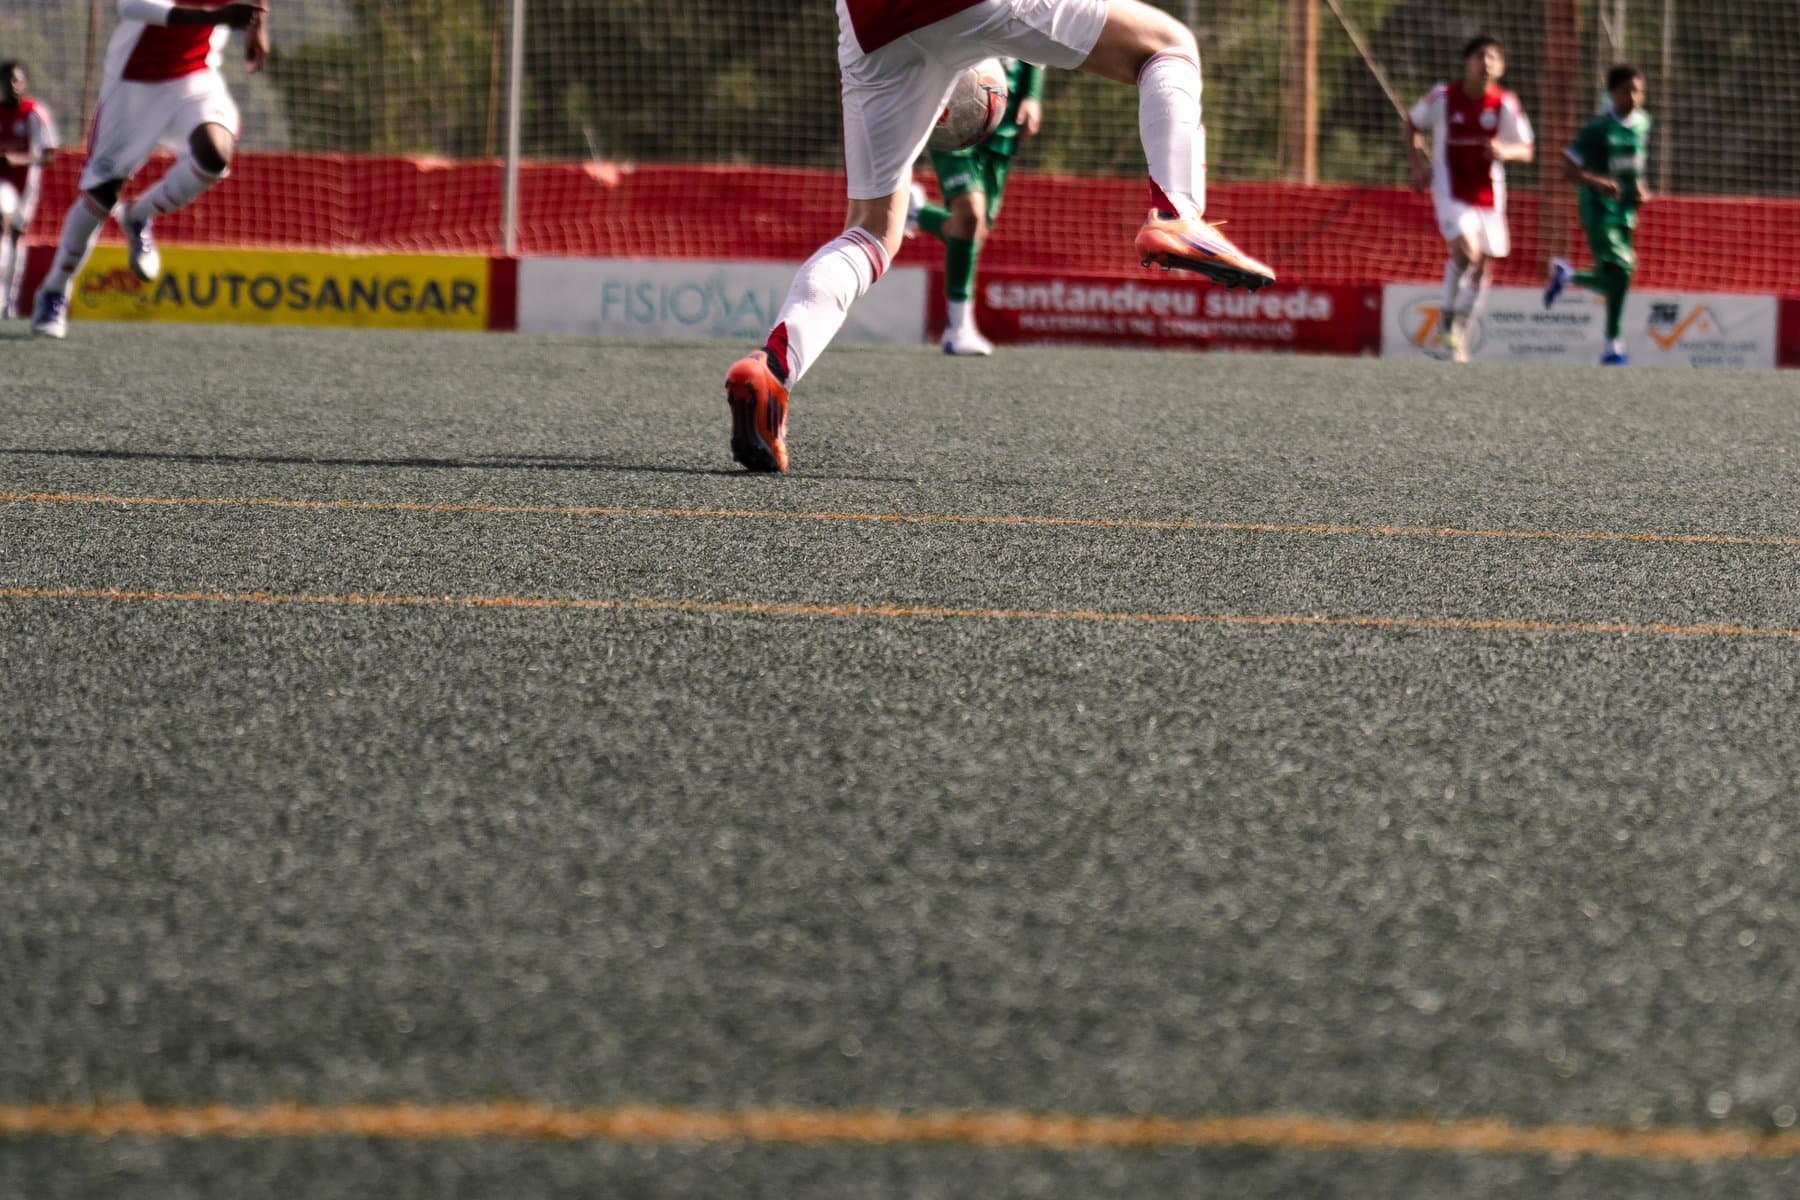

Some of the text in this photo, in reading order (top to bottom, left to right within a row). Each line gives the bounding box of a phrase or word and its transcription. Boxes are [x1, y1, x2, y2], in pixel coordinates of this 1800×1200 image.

[155, 270, 477, 314] AUTOSANGAR
[985, 280, 1332, 322] santandreu sureda
